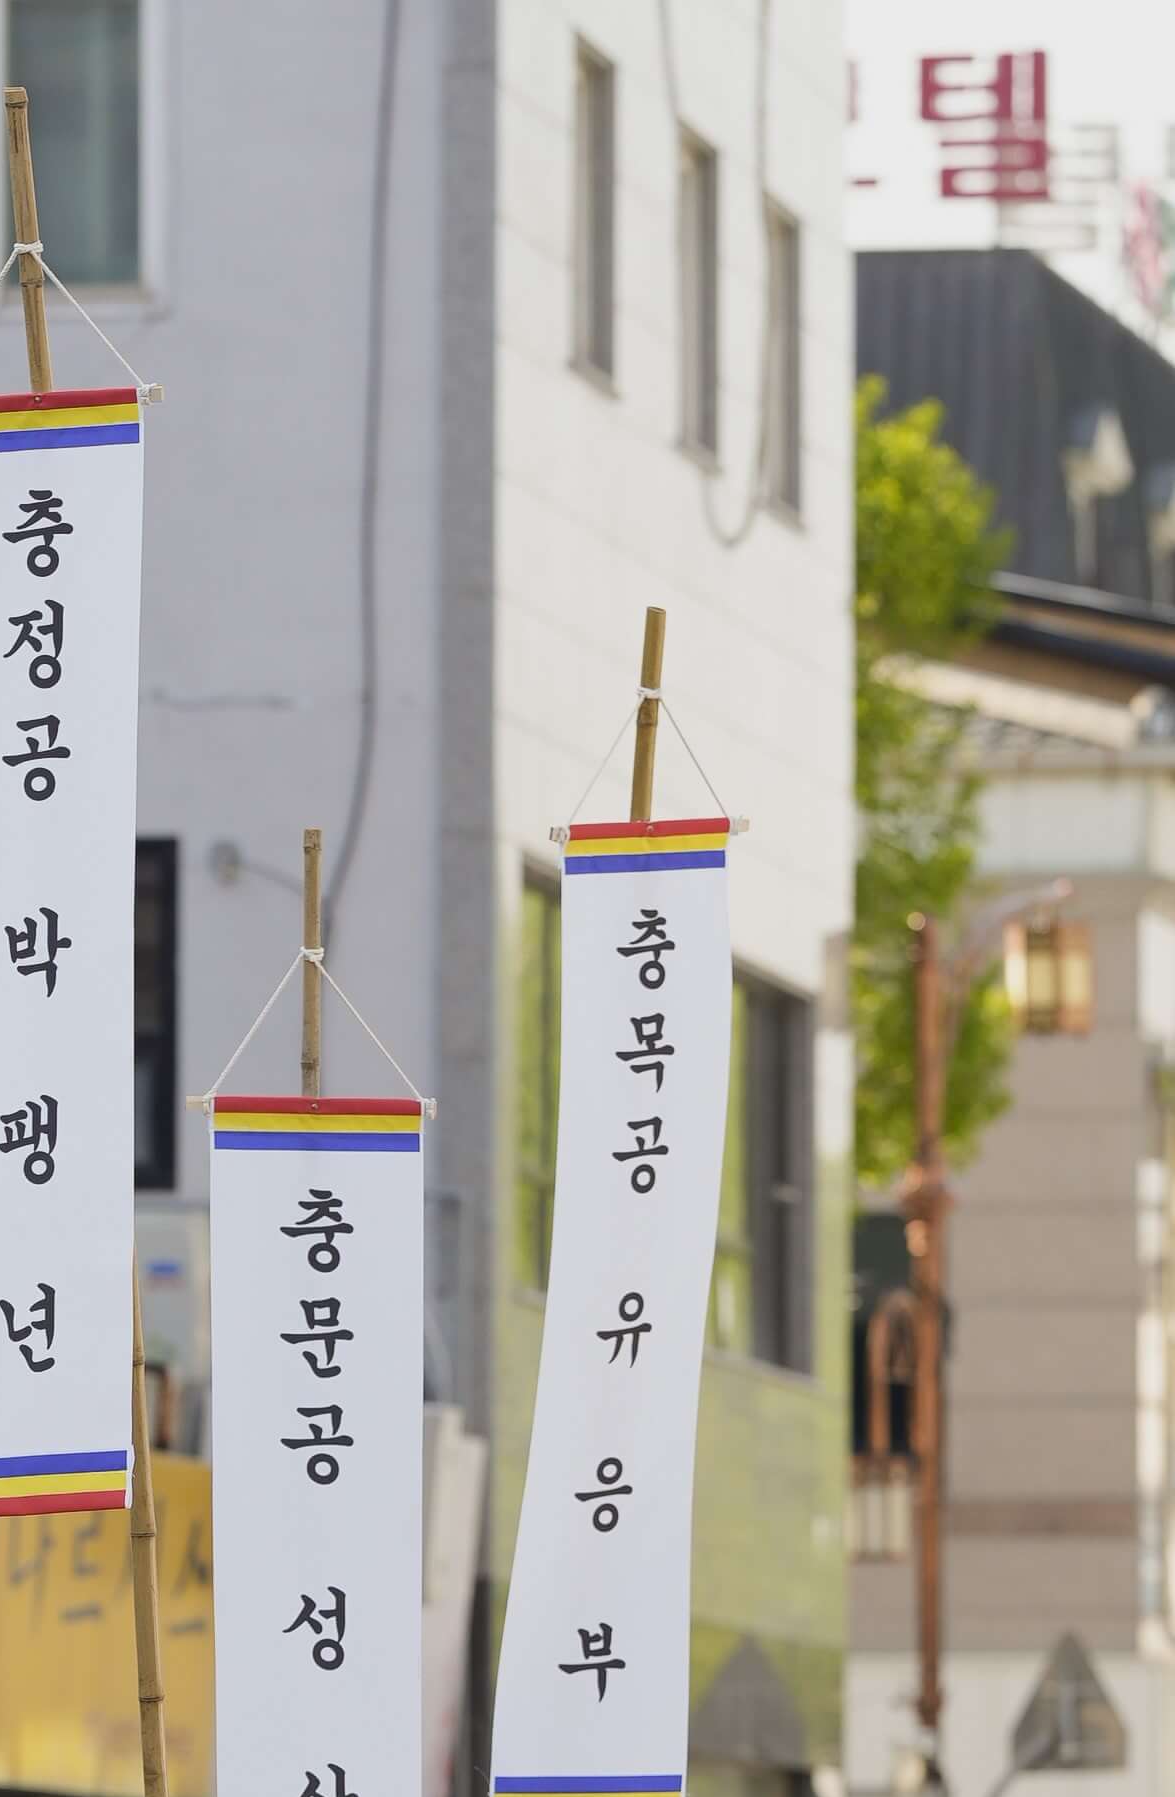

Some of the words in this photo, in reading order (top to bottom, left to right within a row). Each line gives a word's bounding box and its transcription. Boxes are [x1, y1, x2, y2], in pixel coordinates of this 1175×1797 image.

[3, 490, 73, 801] 충정공
[613, 910, 674, 1193] 충목공
[280, 1189, 353, 1484] 충문공
